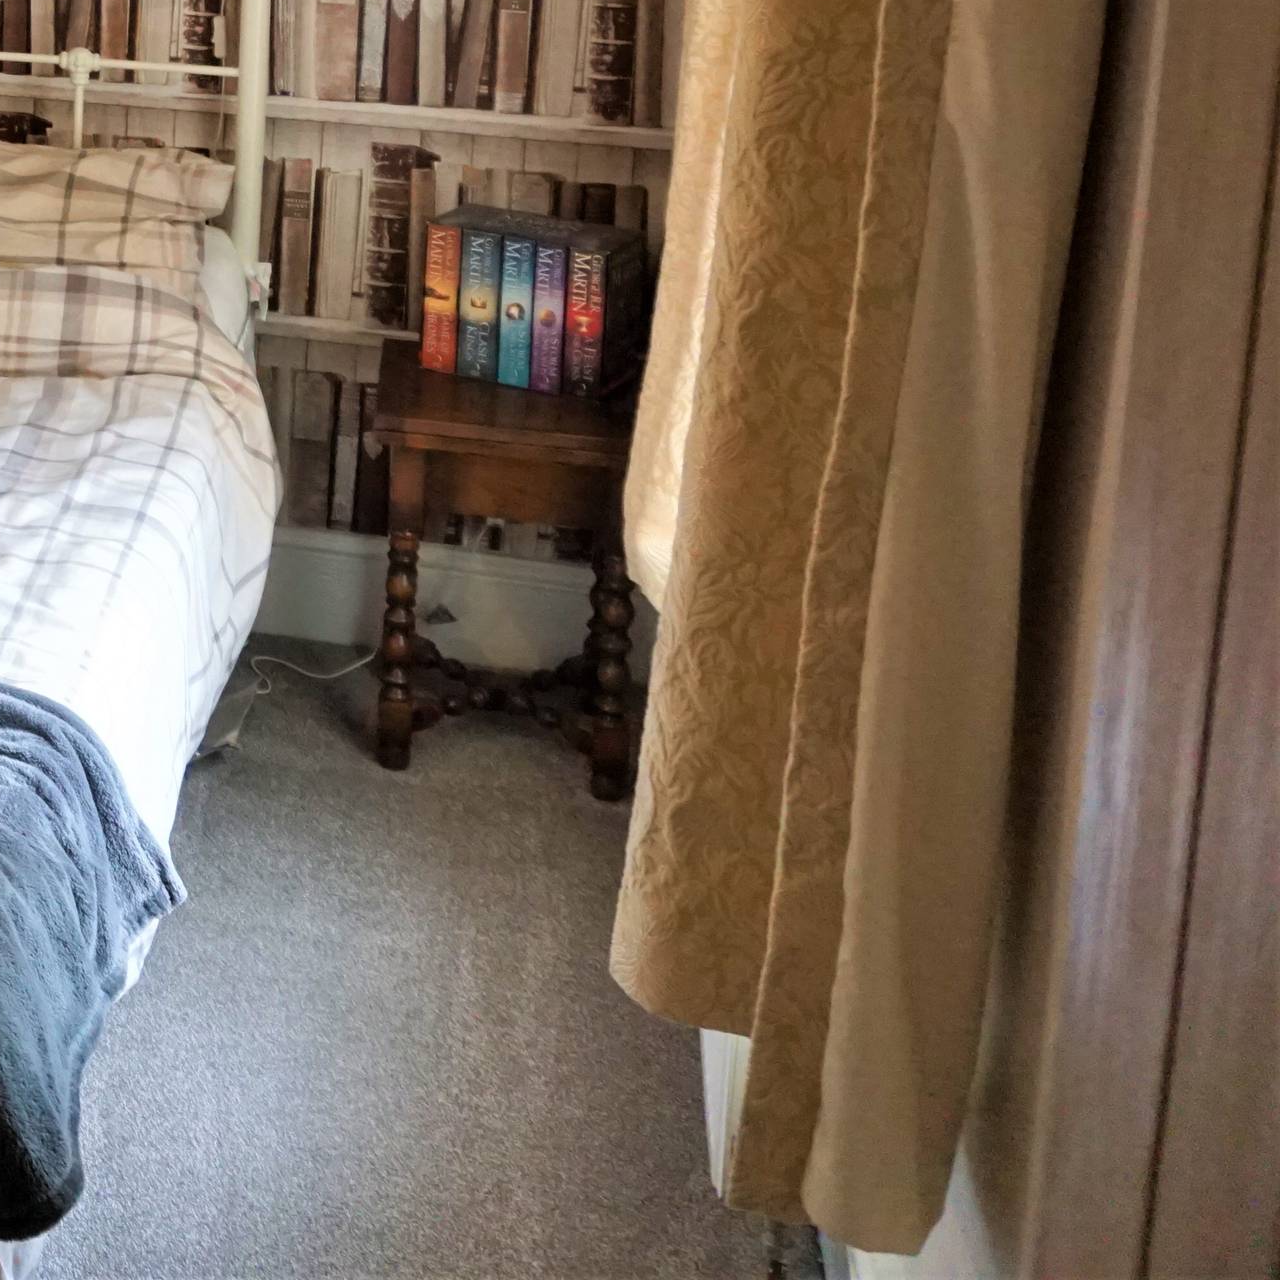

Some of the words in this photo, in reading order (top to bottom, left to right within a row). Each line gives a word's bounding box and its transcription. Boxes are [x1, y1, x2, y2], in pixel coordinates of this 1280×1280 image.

[504, 241, 520, 292] MARTI
[538, 247, 554, 300] MARTI
[572, 252, 591, 315] MARTIN
